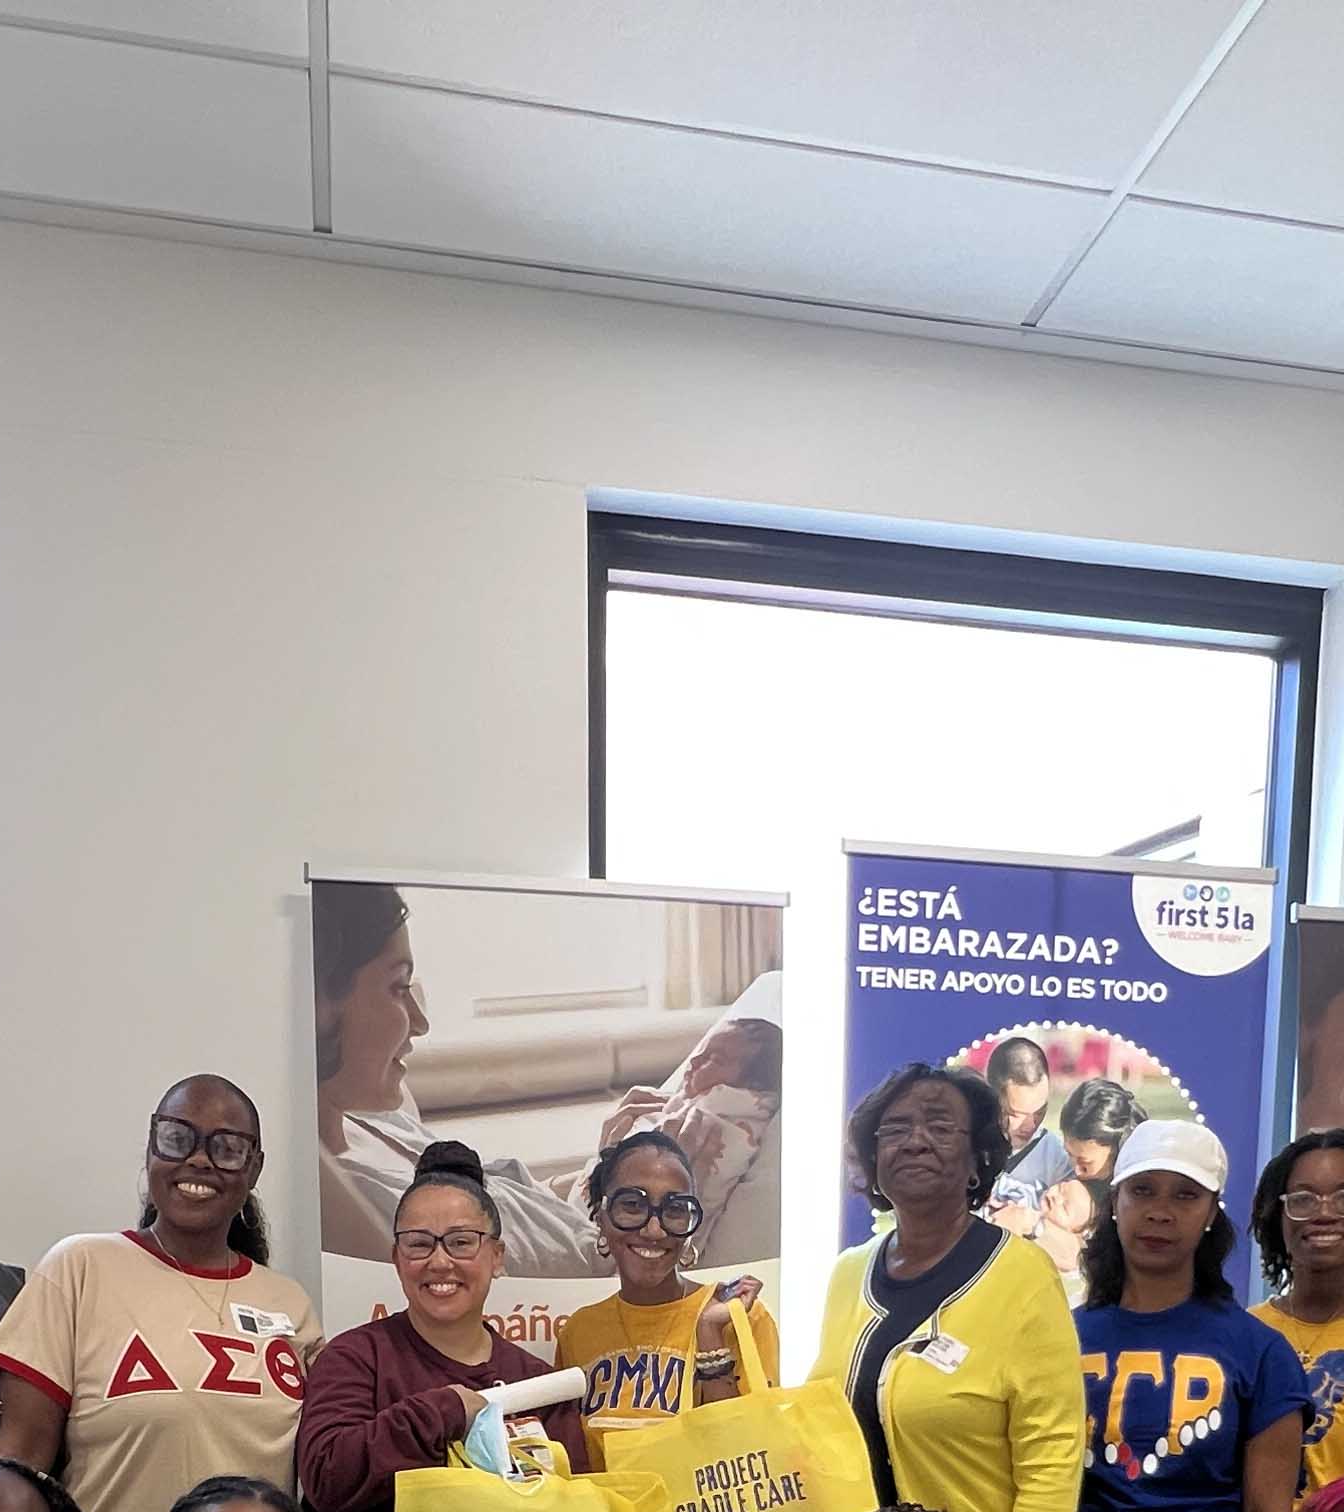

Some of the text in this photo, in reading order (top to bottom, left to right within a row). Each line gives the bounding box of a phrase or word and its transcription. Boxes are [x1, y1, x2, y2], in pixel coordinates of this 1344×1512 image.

[857, 885, 962, 921] ¿ESTÁ
[1156, 900, 1255, 931] first 5 la
[857, 923, 1120, 966] EMBARAZADA?
[856, 966, 1168, 1004] TENER APOYO LO ES TODO
[694, 1449, 770, 1497] PROJECT
[754, 1471, 807, 1511] CARE
